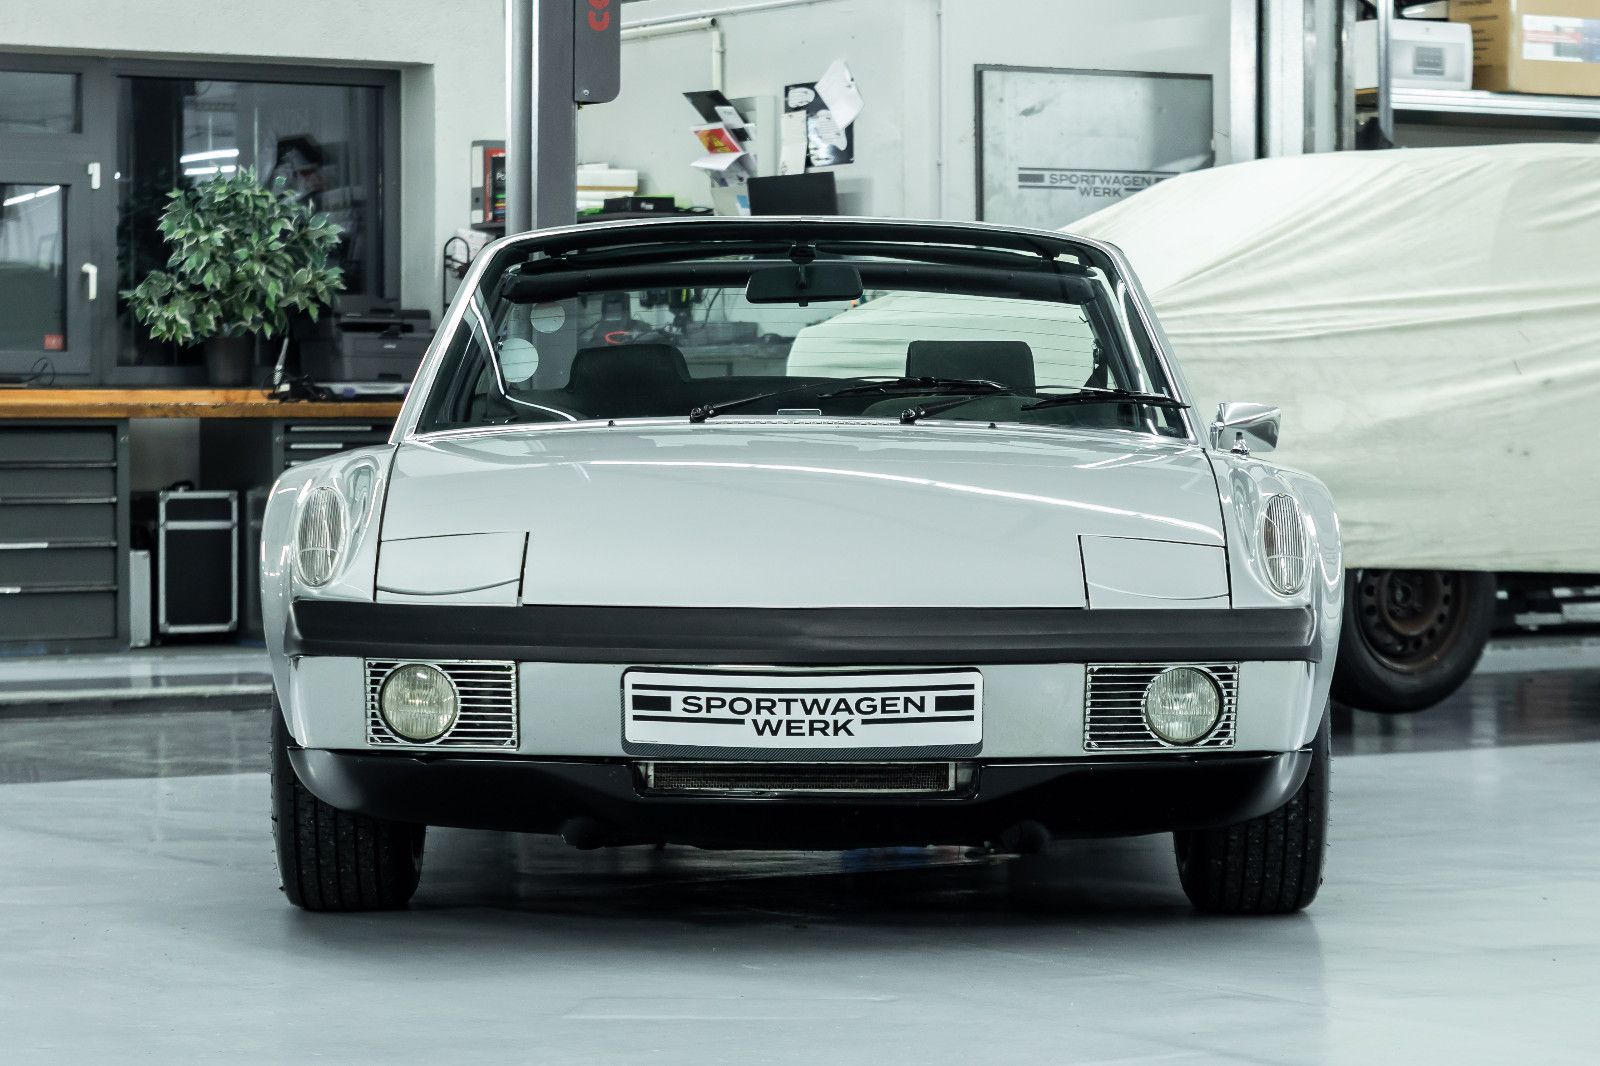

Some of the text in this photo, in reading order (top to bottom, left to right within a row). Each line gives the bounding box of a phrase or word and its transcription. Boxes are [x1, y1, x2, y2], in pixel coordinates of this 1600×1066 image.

[1049, 173, 1152, 187] SPORTWAGEN
[1078, 186, 1121, 198] WERK
[681, 695, 926, 716] SPORTWAGEN
[751, 718, 855, 737] WERK
